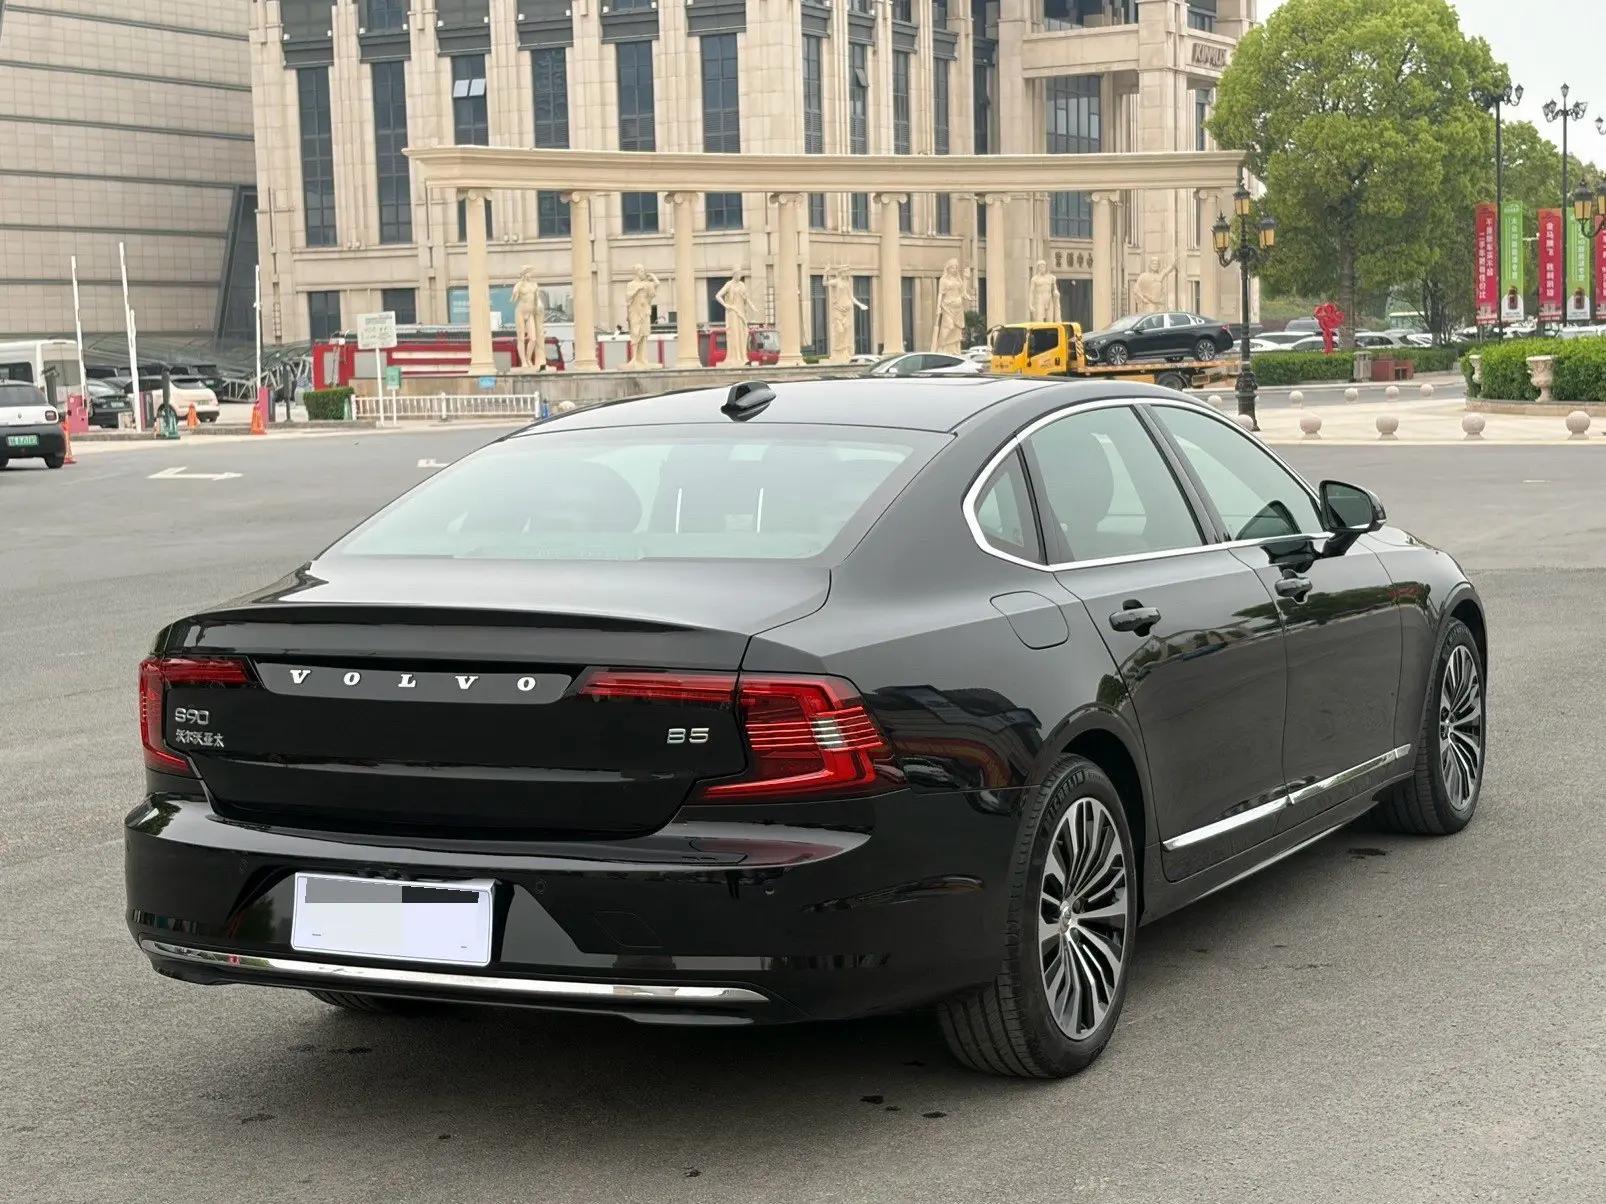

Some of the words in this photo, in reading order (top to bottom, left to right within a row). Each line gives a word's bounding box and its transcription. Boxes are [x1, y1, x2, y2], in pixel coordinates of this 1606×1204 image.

[289, 669, 537, 692] VOLVO
[174, 707, 210, 726] S90
[666, 727, 710, 744] B5
